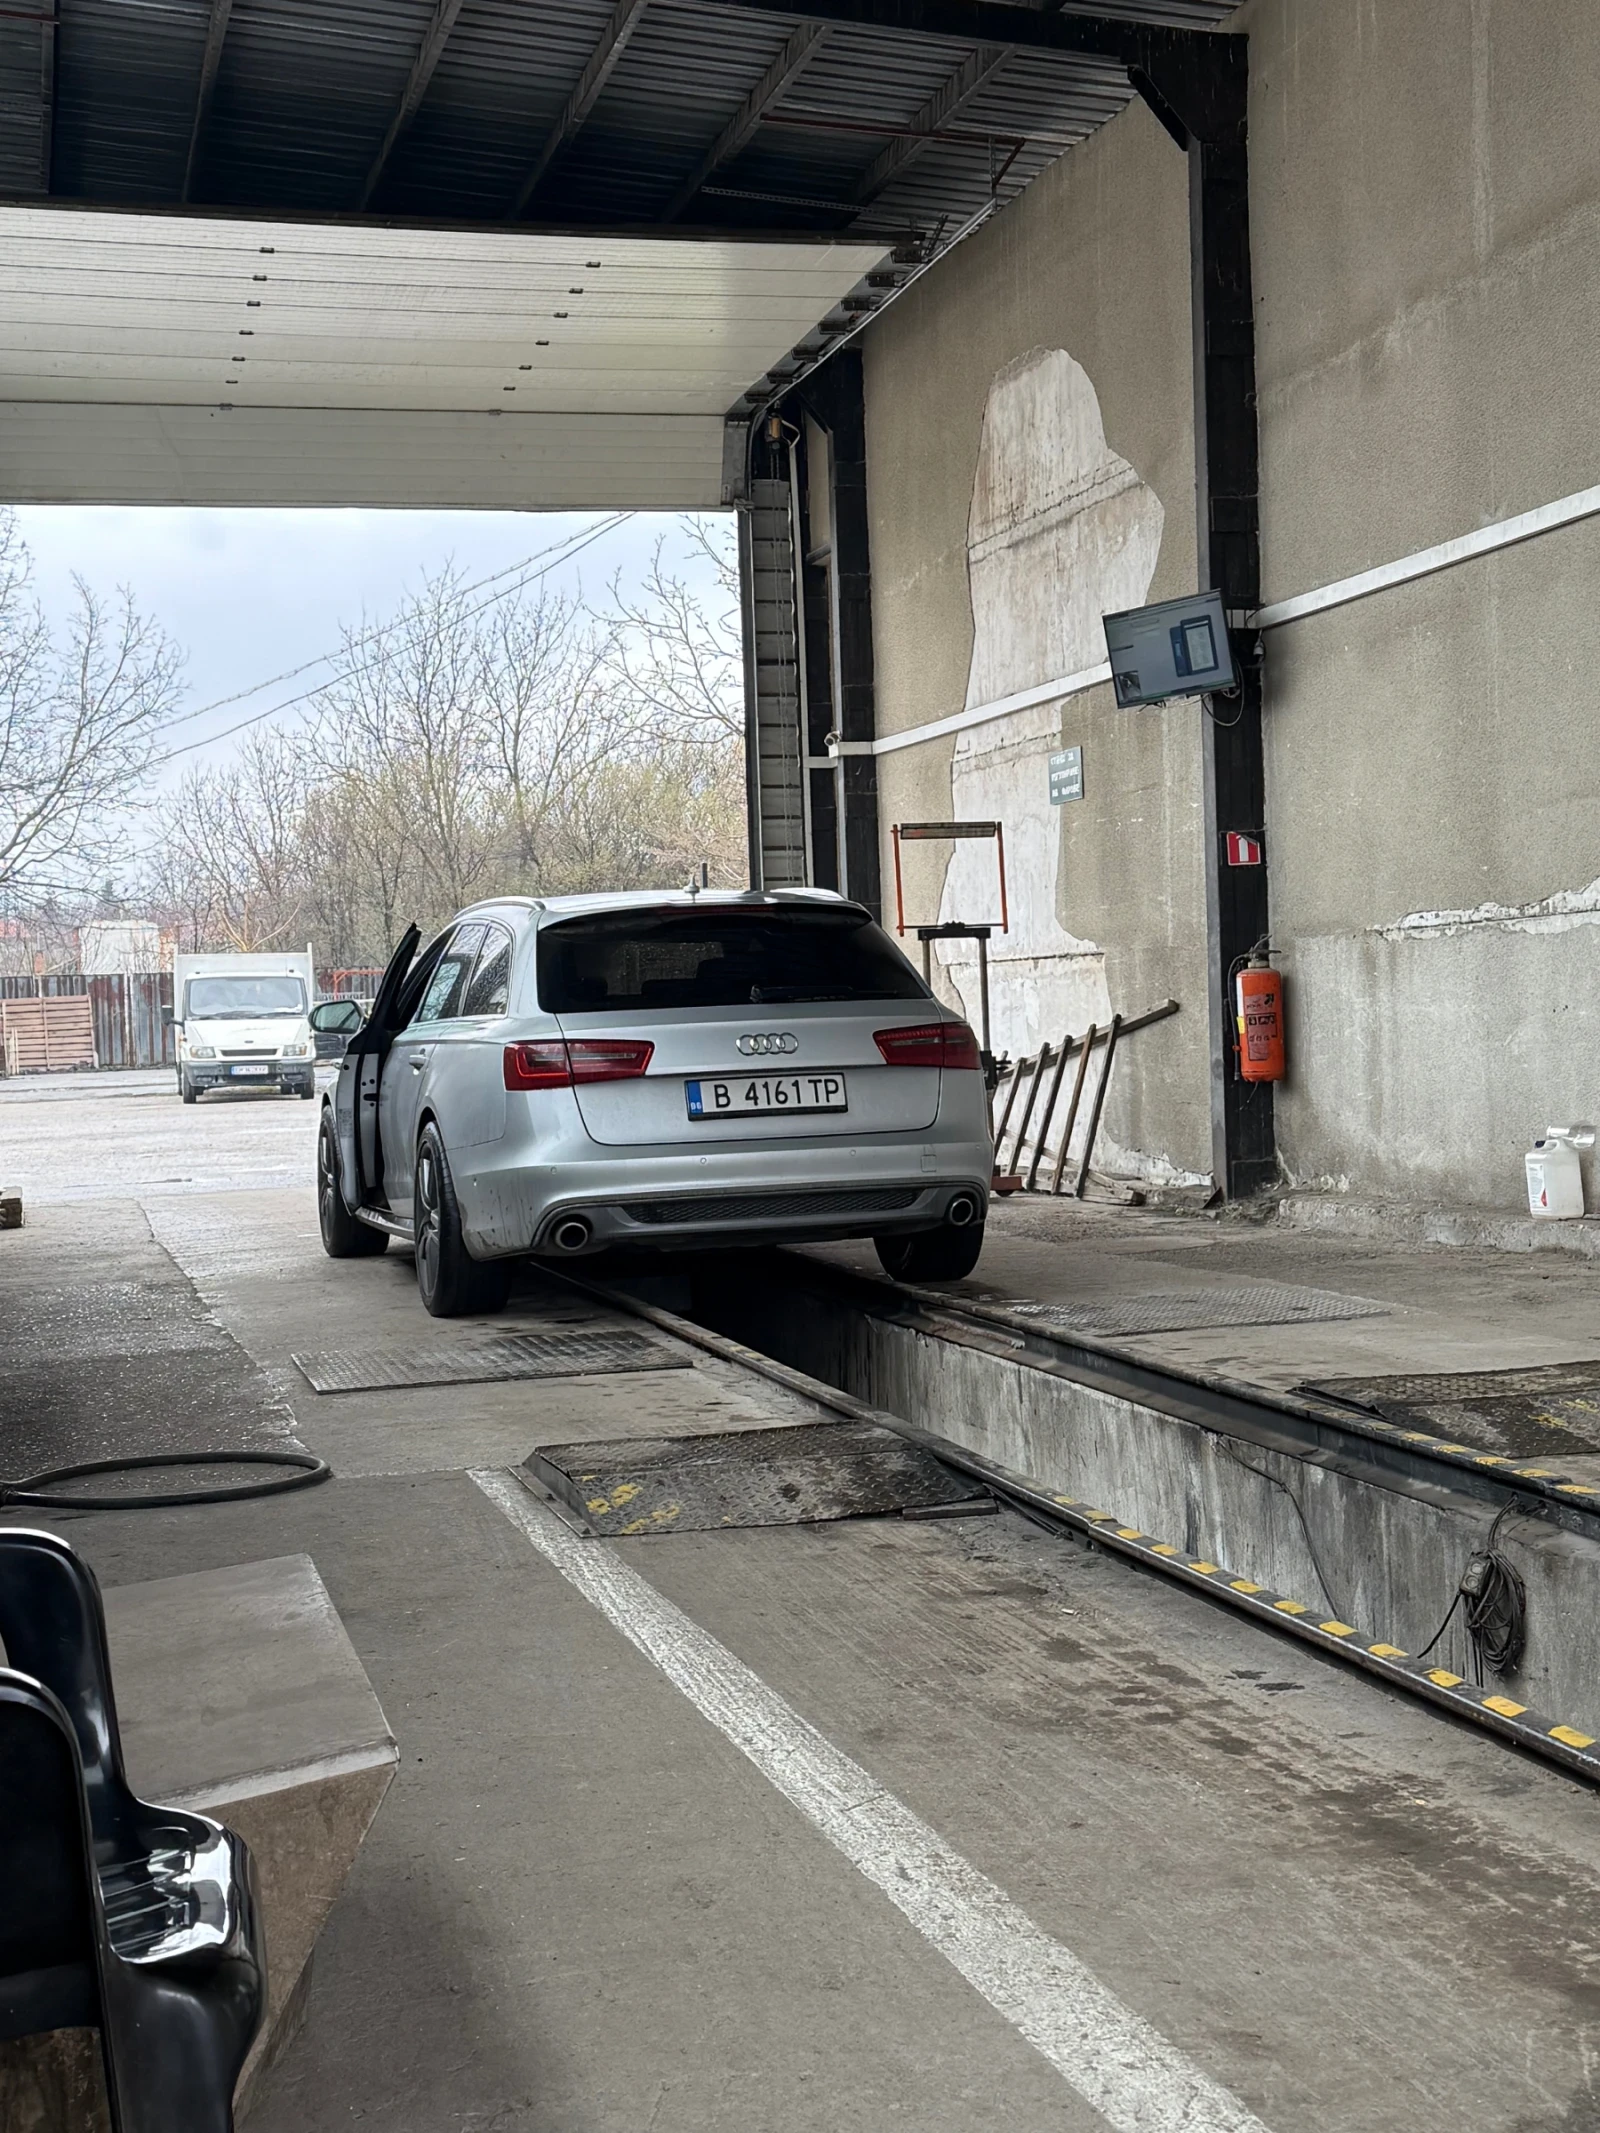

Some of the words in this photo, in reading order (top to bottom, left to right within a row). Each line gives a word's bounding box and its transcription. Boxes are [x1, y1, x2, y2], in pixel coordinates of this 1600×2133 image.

[714, 1084, 731, 1108] B
[745, 1080, 801, 1106] 4161
[808, 1079, 839, 1103] TP
